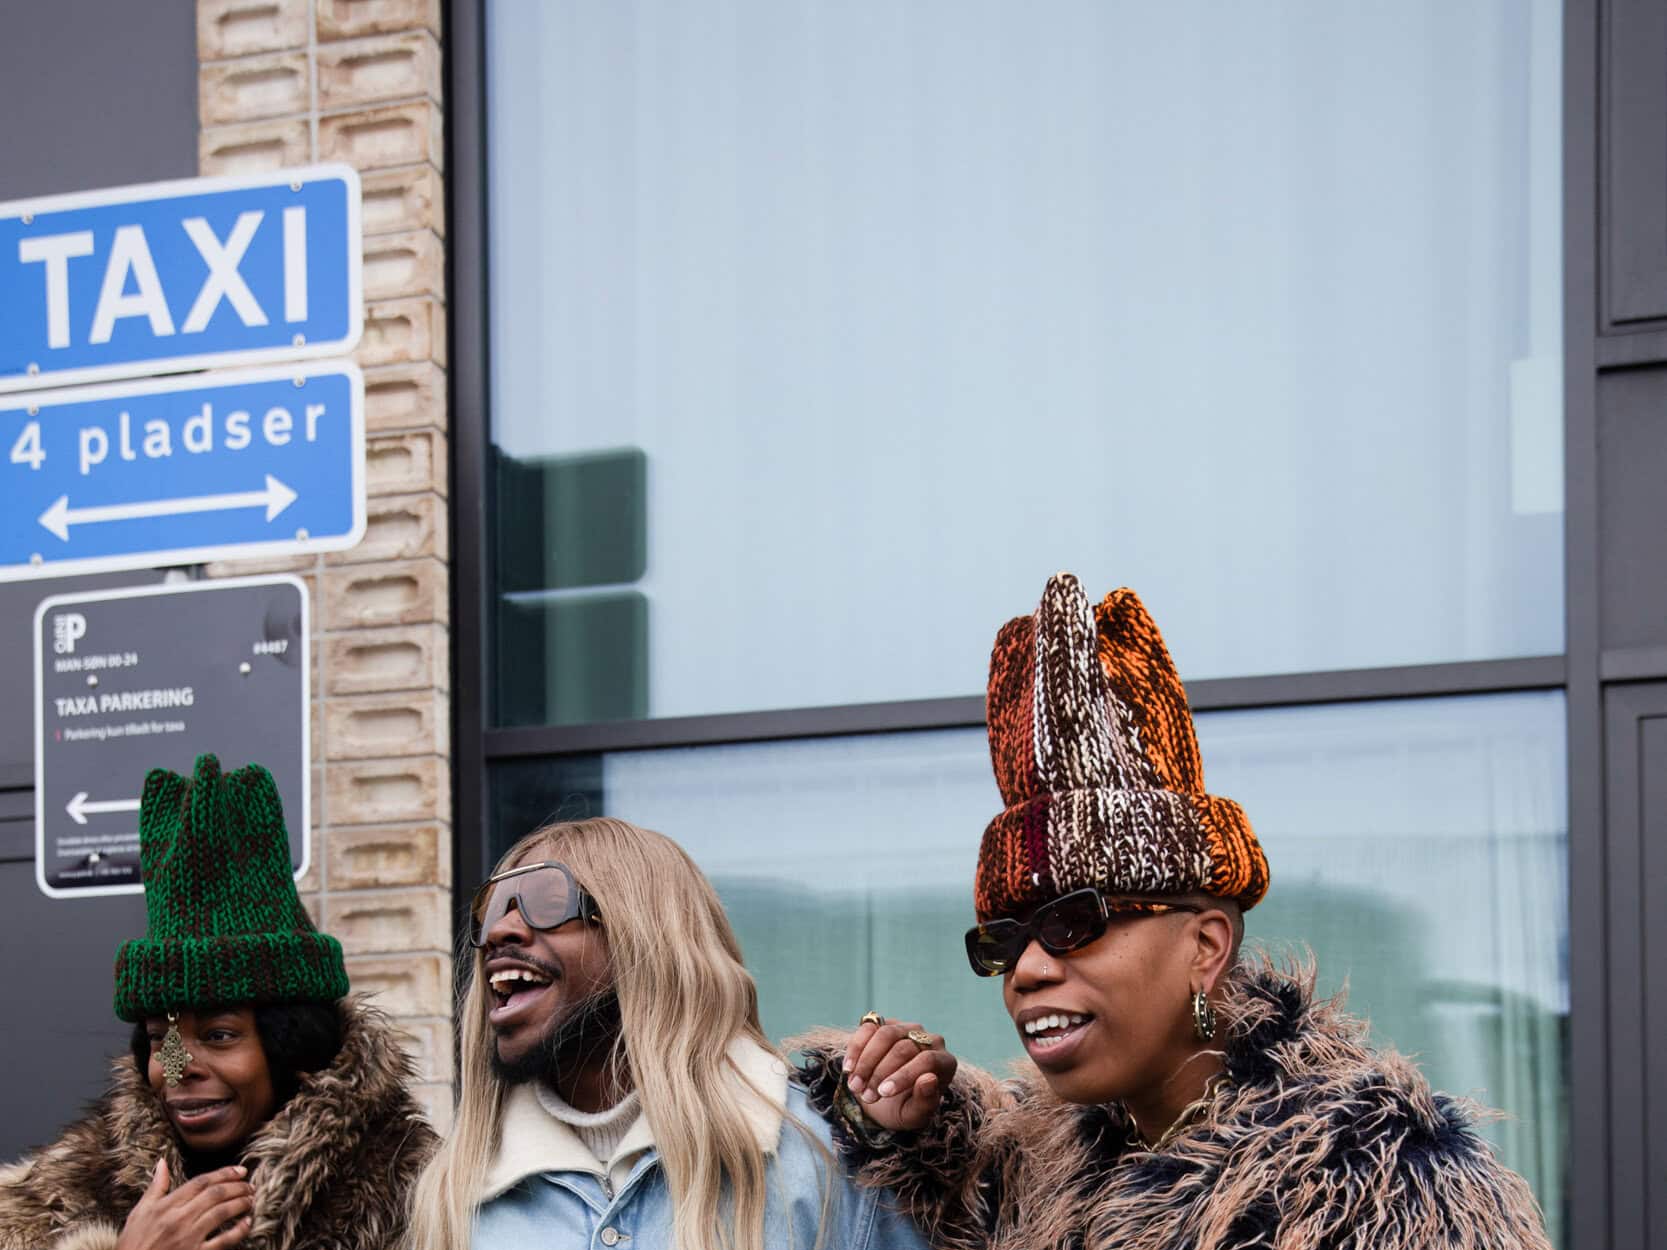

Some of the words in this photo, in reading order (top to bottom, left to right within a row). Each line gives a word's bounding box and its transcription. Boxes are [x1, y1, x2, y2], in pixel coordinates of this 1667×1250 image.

[19, 206, 308, 349] TAXI
[10, 422, 46, 470] 4
[79, 403, 325, 475] pladser
[56, 696, 98, 716] TAXA
[100, 687, 192, 712] PARKERING
